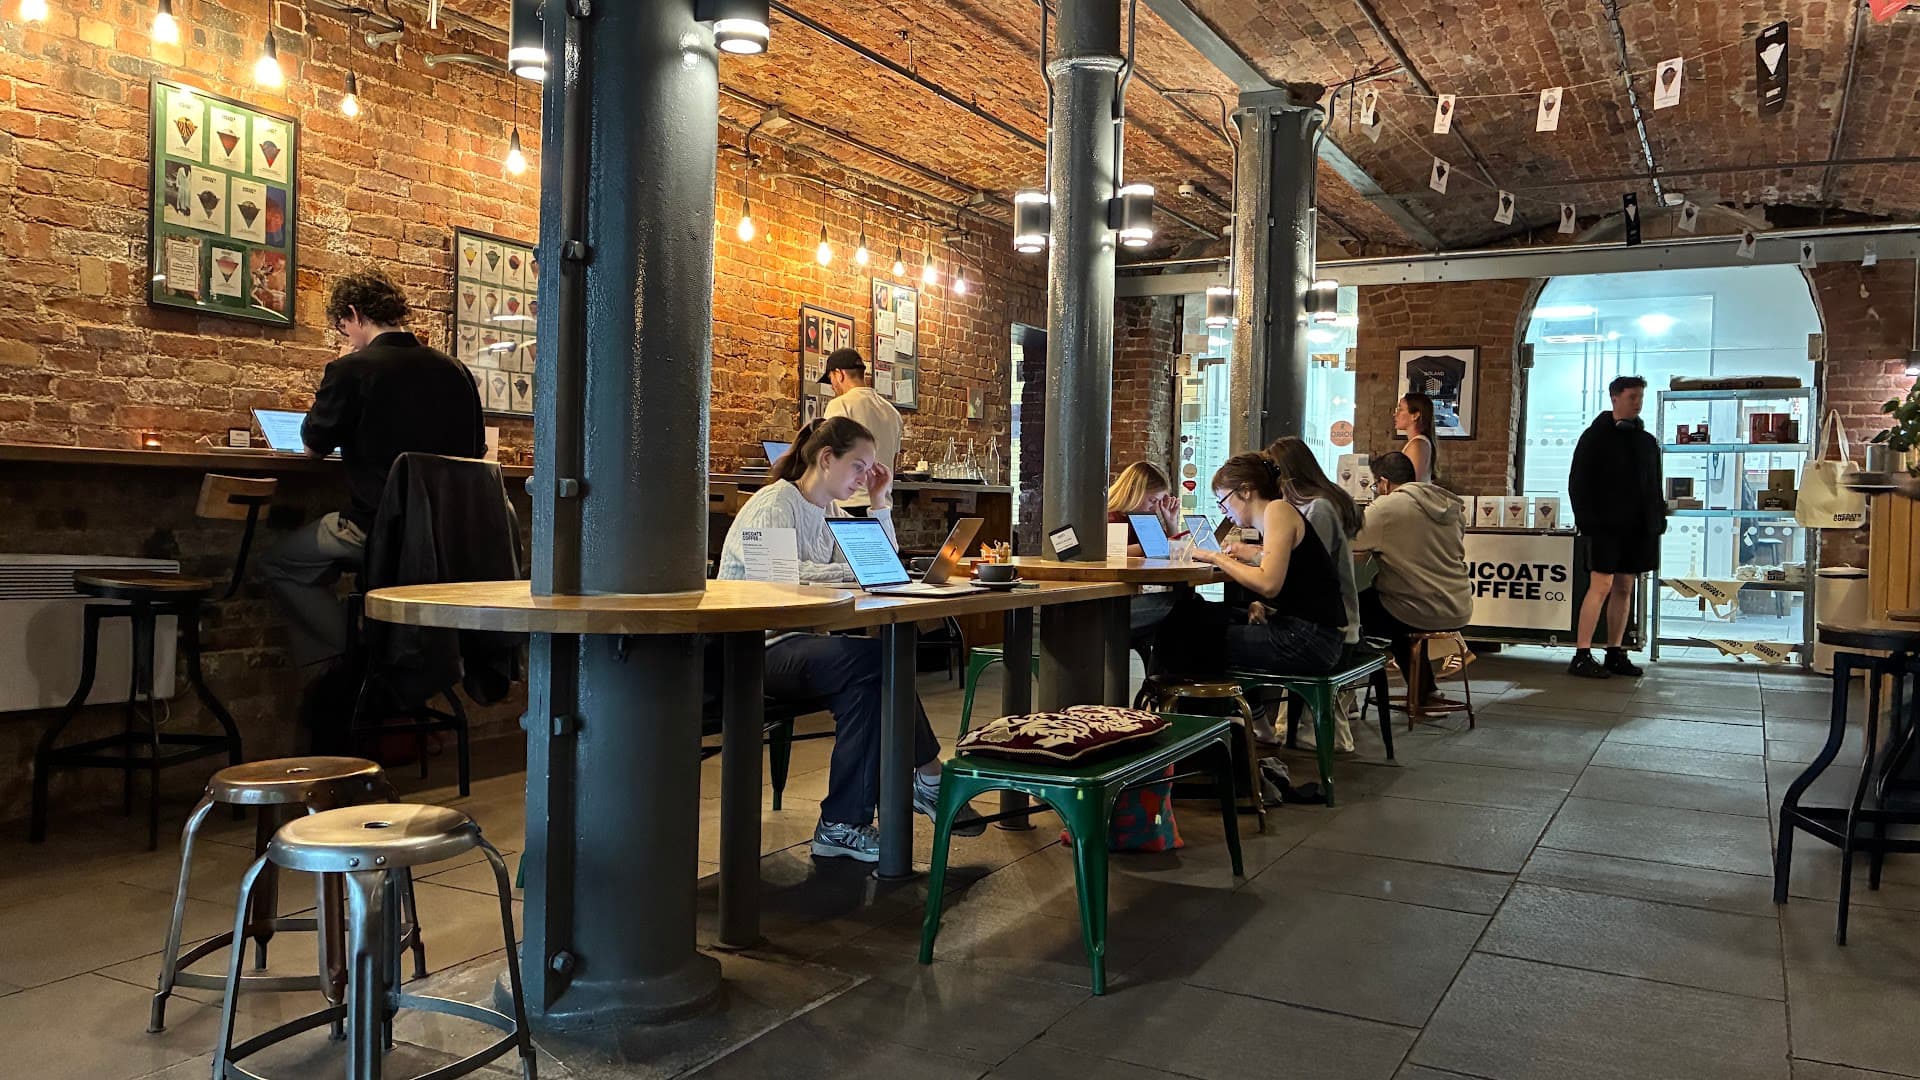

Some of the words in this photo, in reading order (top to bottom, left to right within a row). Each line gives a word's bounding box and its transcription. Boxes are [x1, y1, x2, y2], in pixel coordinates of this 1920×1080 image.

[1468, 561, 1567, 582] COATS
[1471, 580, 1541, 600] FFEE
[1544, 591, 1567, 602] CO.
